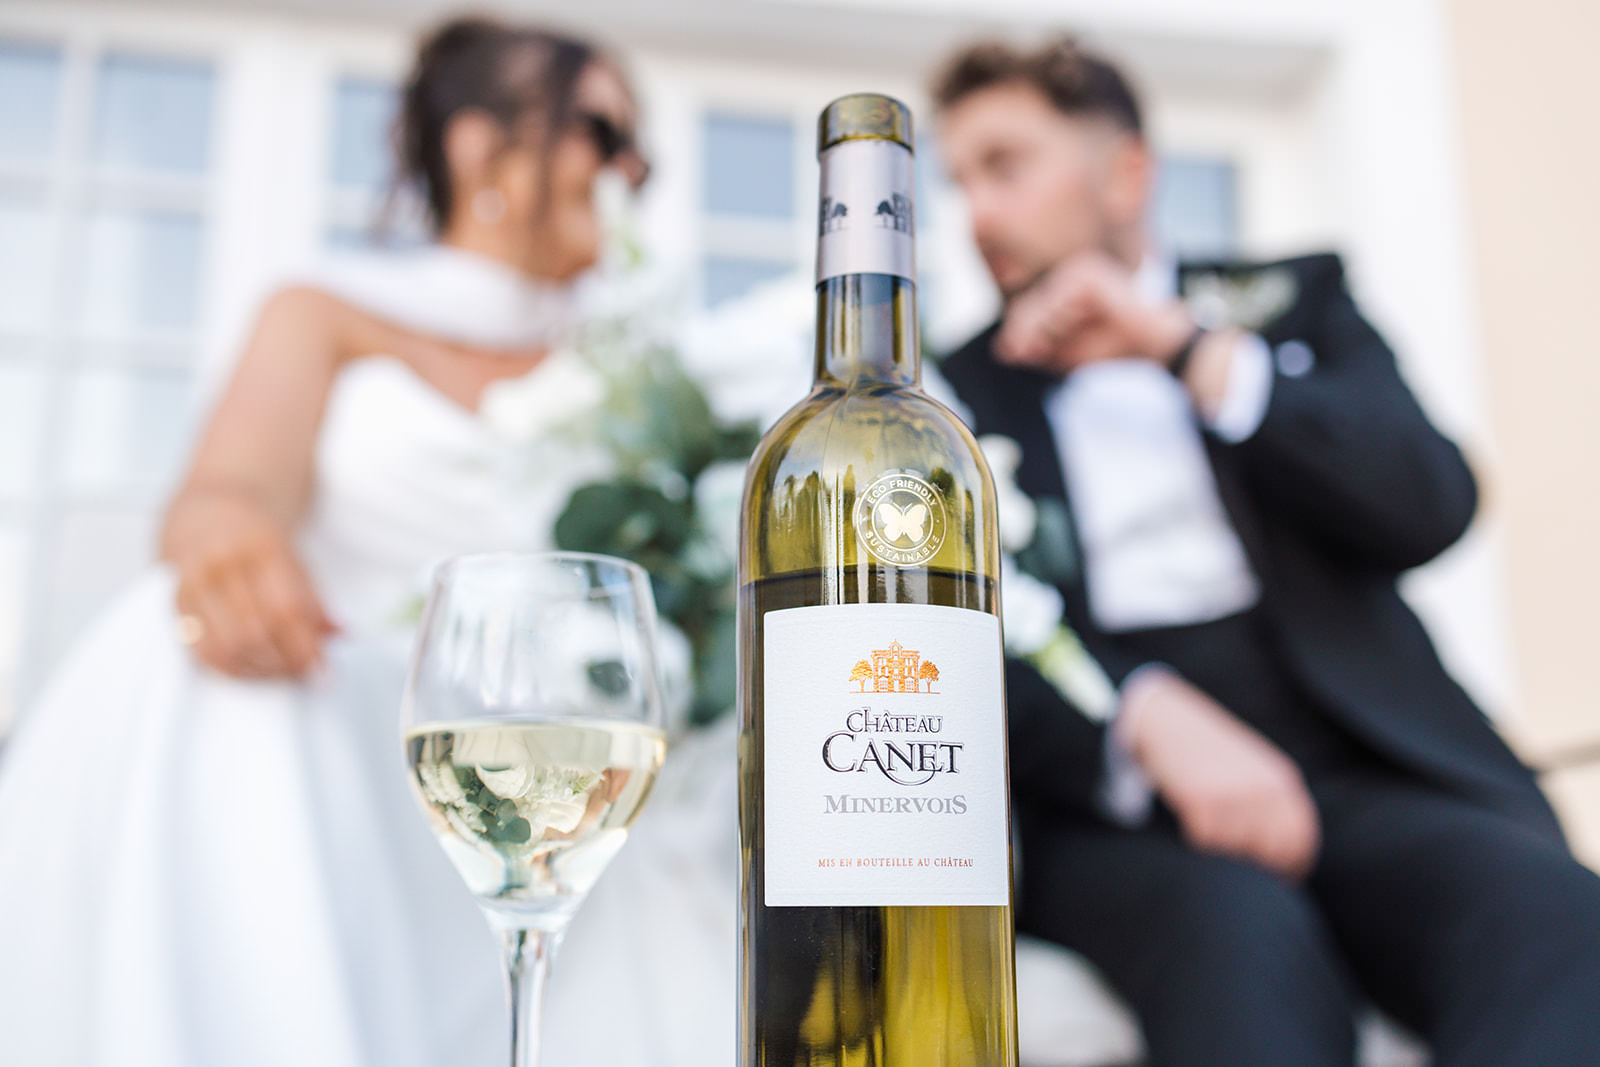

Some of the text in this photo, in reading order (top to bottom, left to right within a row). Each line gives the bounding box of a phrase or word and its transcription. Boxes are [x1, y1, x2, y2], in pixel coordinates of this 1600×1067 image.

[866, 479, 938, 506] ECO FRIENDLY
[865, 531, 940, 562] SUSTAINABLE
[846, 706, 943, 734] CHÂTEAU
[822, 730, 965, 786] CANET
[823, 794, 968, 815] MINERVOIS
[818, 856, 974, 868] MIS EN BOUTEILLE AU CHÂTEAU
